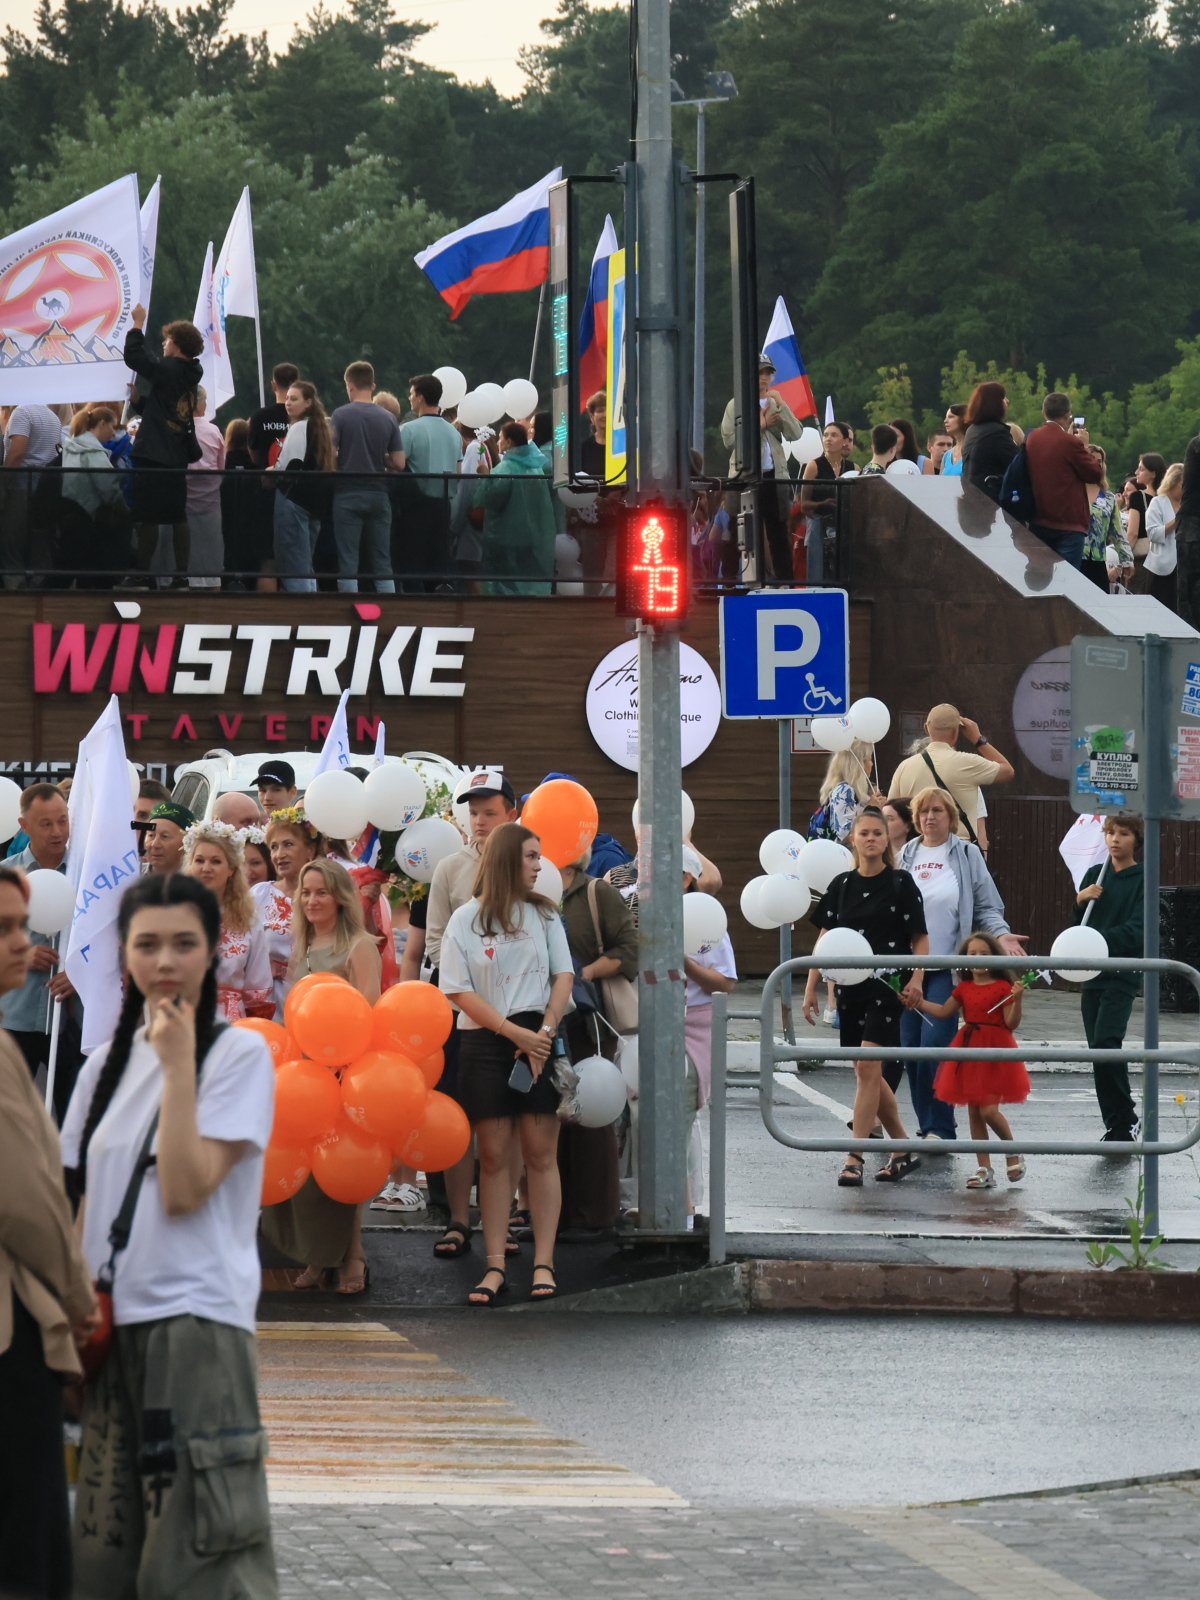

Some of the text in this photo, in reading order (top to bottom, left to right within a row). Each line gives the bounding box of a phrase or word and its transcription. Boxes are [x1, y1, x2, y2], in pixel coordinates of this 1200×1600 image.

[757, 609, 821, 700] P
[126, 713, 383, 742] TAVERN
[1097, 753, 1132, 762] КУПЛЮ
